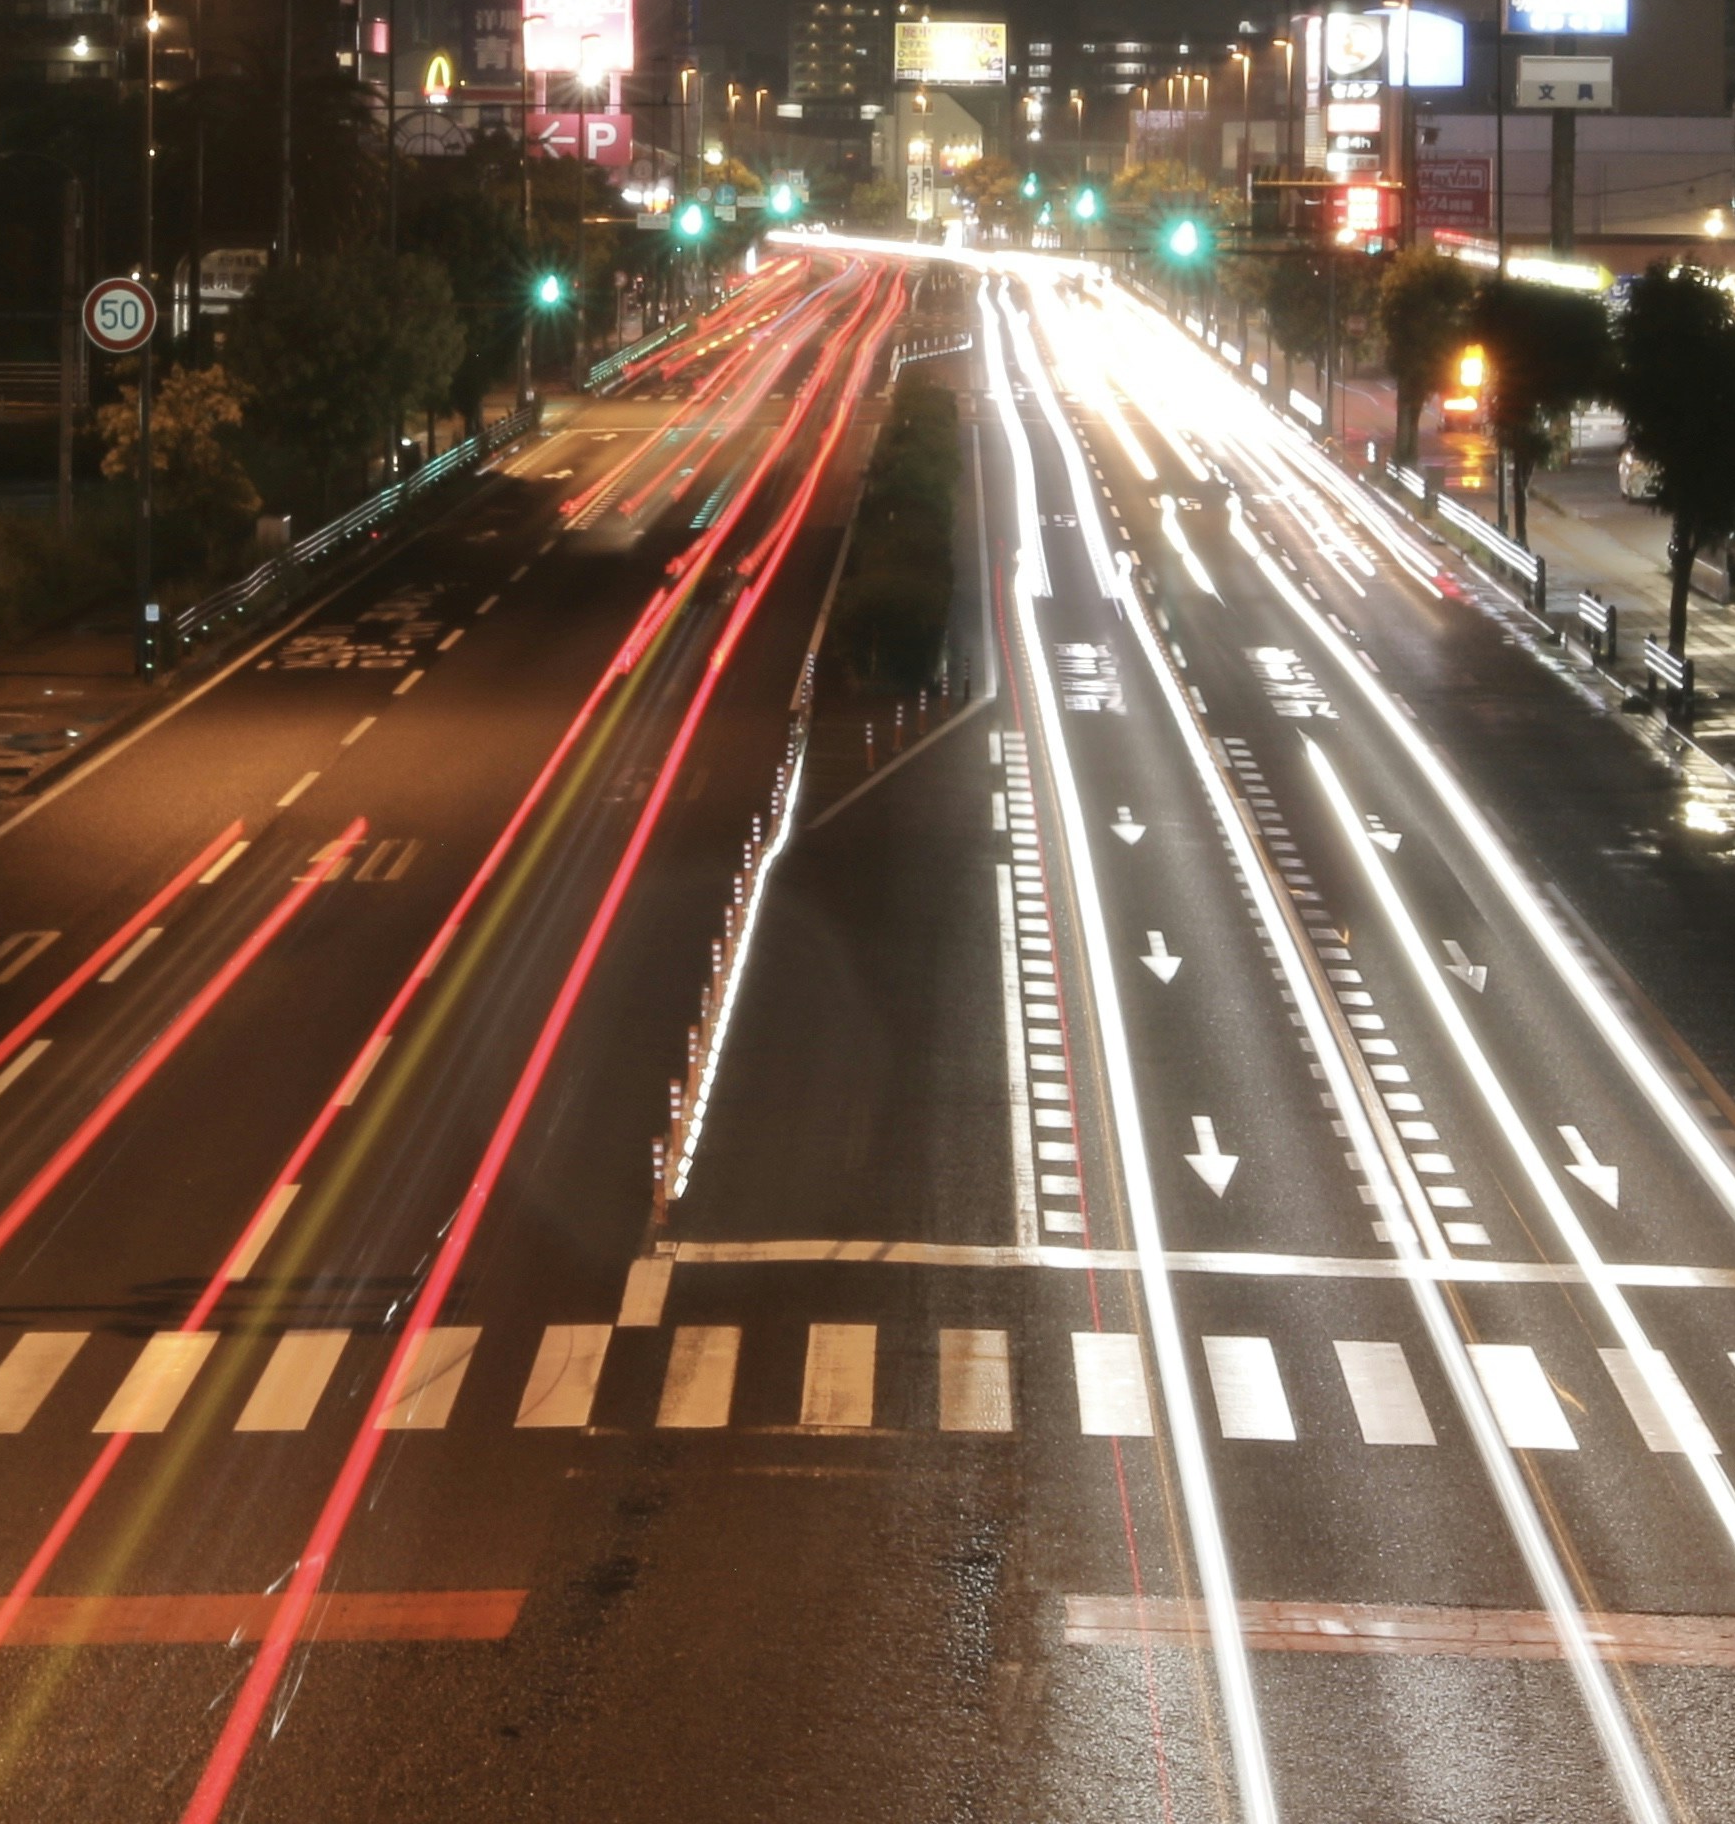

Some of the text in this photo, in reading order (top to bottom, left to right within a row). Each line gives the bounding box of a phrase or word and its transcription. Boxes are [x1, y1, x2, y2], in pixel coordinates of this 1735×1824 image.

[1331, 82, 1380, 99] セルフ
[587, 122, 617, 160] P
[100, 298, 139, 330] 50
